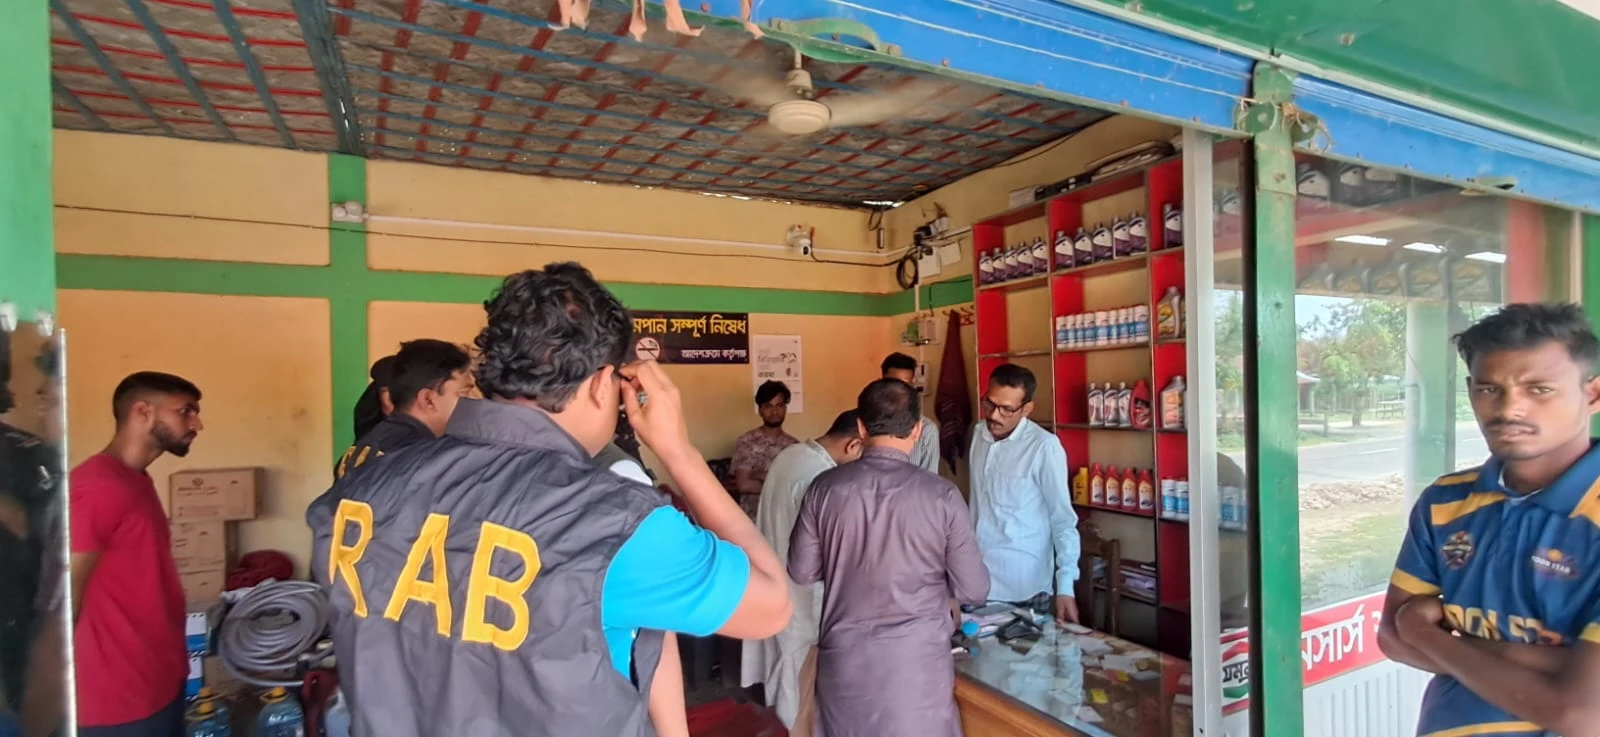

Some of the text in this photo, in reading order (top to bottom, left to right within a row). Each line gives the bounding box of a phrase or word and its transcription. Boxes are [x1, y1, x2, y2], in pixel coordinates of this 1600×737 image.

[632, 313, 747, 338] মপান সম্পূর্ণ নিষেধ
[329, 499, 541, 650] RAB
